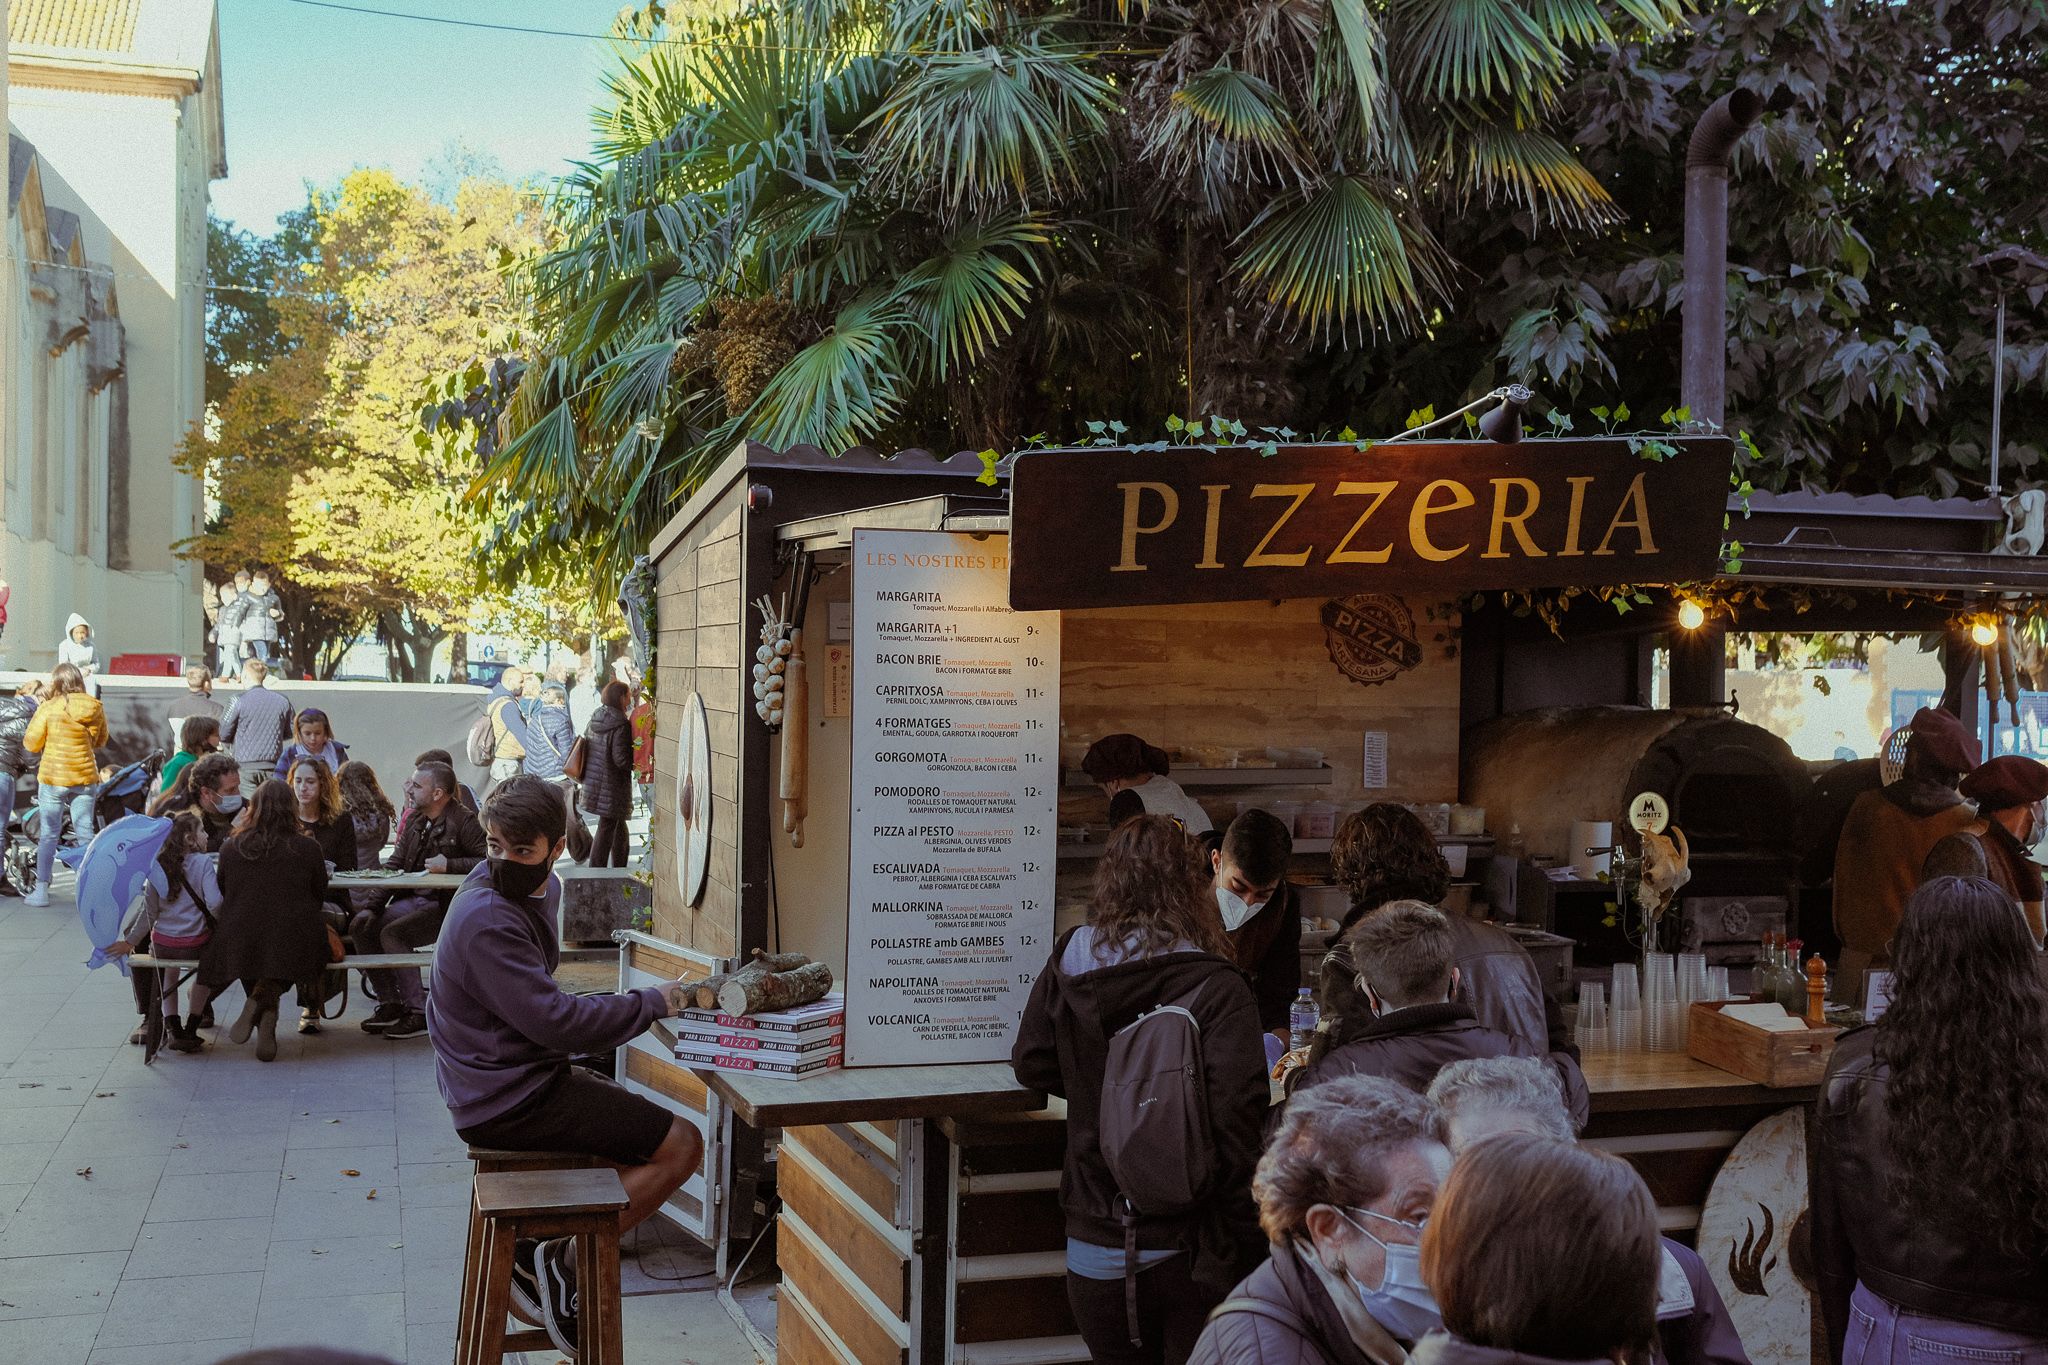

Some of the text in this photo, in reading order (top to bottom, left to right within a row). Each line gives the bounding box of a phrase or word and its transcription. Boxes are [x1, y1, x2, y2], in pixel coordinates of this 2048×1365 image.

[867, 553, 897, 566] LES
[904, 554, 985, 568] NOSTRES
[876, 591, 941, 602] MARGARITA
[913, 604, 946, 612] Tomaquet,
[876, 623, 941, 634] MARGARITA
[1336, 610, 1404, 660] PIZZA
[876, 654, 915, 665] BACON
[918, 655, 941, 665] BRIE
[944, 659, 977, 667] Tomaquet,
[1335, 641, 1388, 676] ARTESANA
[876, 685, 1014, 699] CAPRITXOSA Tomaquet, Mozzarella
[909, 698, 928, 706] DOLC,
[930, 698, 974, 706] XAMPINYONS,
[885, 718, 951, 728] FORMATGES
[954, 722, 987, 730] Tomaquet,
[883, 730, 914, 738] EMENTAL,
[916, 730, 940, 738] GOUDA,
[875, 752, 947, 763] GORGOMOTA
[950, 757, 983, 765] Tomaquet,
[874, 787, 940, 797] POMODORO
[943, 790, 976, 798] Tomaquet,
[908, 798, 941, 806] RODALLES
[1643, 800, 1655, 811] M
[909, 807, 954, 815] XAMPINYONS,
[874, 826, 904, 836] PIZZA
[920, 826, 954, 836] PESTO
[958, 829, 992, 837] Mozzarella,
[873, 863, 940, 874] ESCALIVADA
[943, 866, 976, 874] Tomaquet,
[893, 875, 919, 883] PEBROT,
[872, 902, 943, 912] MALLORKINA
[946, 905, 978, 913] Tomaquet,
[871, 936, 1004, 949] POLLASTRE amb GAMBES
[938, 949, 971, 957] Tomaquet,
[888, 958, 925, 966] POLLASTRE,
[869, 977, 939, 988] NAPOLITANA
[941, 980, 974, 988] Tomaquet,
[903, 988, 934, 996] RODALLES
[945, 987, 981, 995] TOMAQUET
[914, 996, 943, 1004] ANXOVES
[948, 995, 982, 1003] FORMATGE
[698, 1014, 715, 1022] LLEVAR
[720, 1017, 752, 1027] PIZZA
[868, 1014, 930, 1025] VOLCANICA
[933, 1017, 966, 1025] Tomaquet,
[685, 1032, 698, 1040] PARA
[699, 1034, 717, 1042] LLEVAR
[723, 1037, 755, 1048] PIZZA
[763, 1042, 777, 1050] PARA
[778, 1043, 797, 1051] LLEVAR
[681, 1053, 694, 1061] PARA
[719, 1057, 751, 1069] PIZZA
[773, 1064, 791, 1072] LLEVAR
